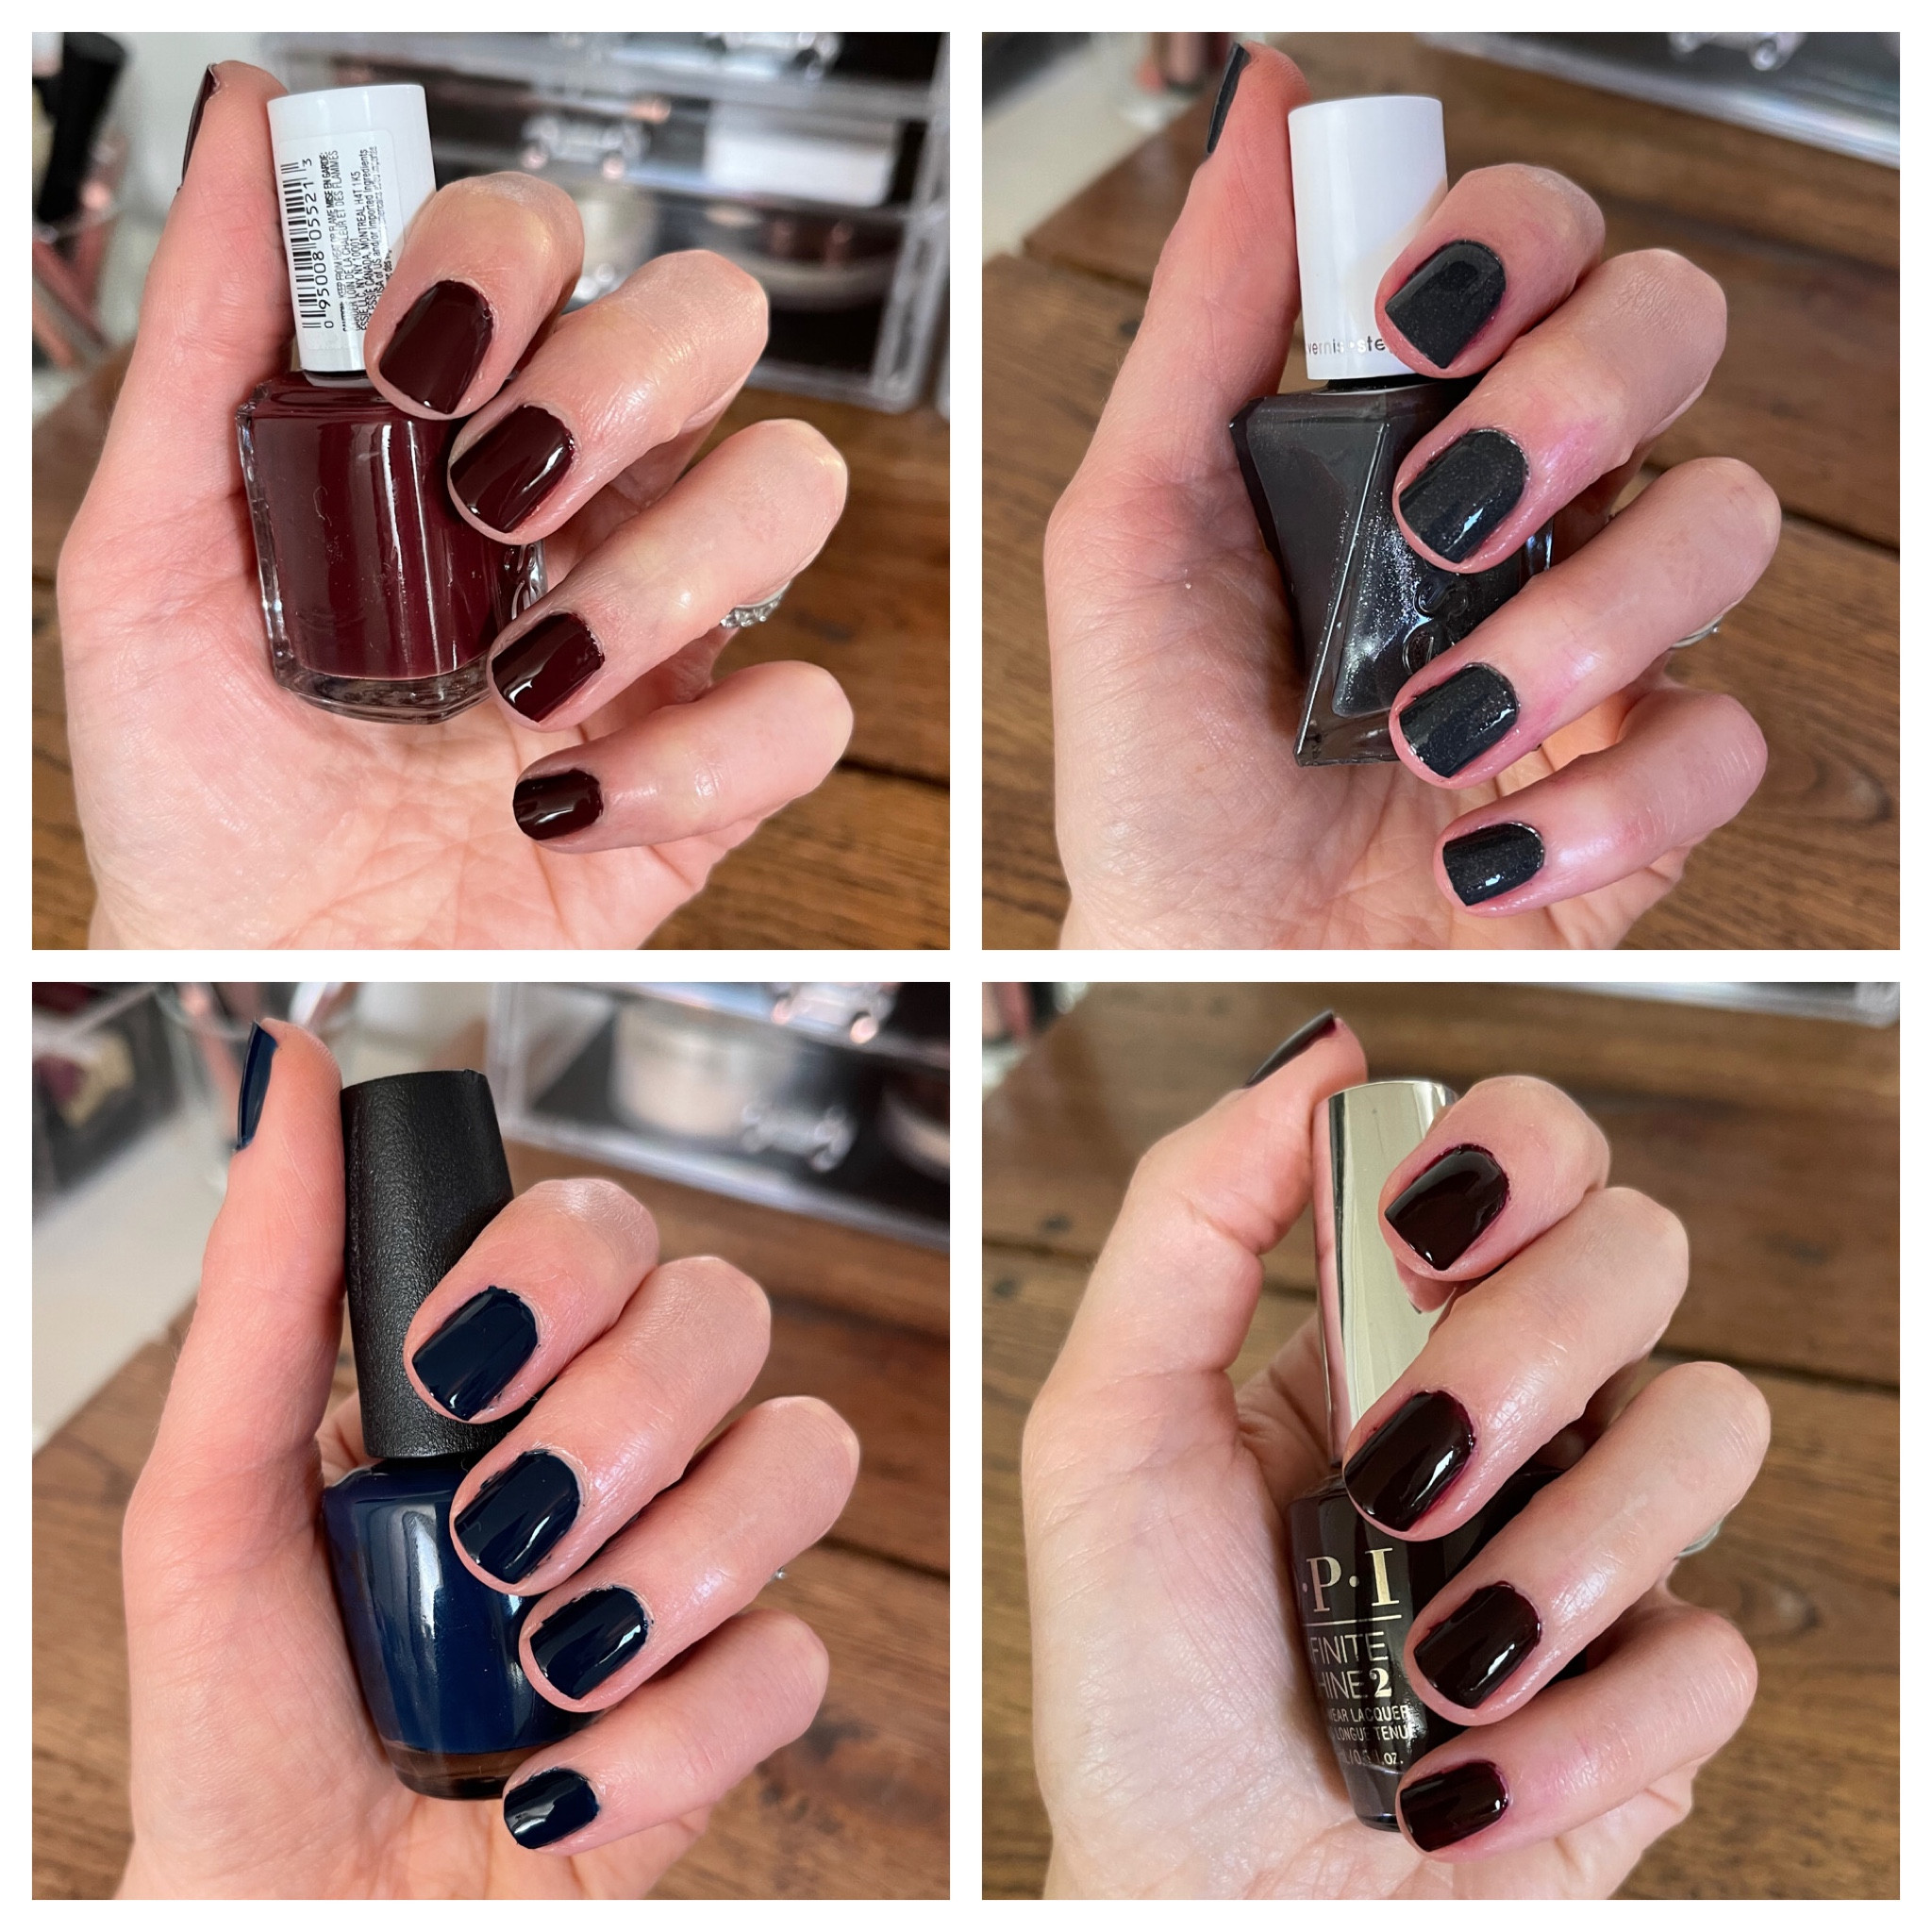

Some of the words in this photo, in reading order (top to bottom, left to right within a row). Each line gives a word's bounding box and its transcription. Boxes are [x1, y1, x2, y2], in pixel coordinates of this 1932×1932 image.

[302, 158, 311, 167] 3
[327, 150, 342, 189] FLAMMES
[357, 147, 375, 192] Ingredients
[322, 178, 331, 189] EN
[350, 170, 361, 186] 1K5
[333, 191, 344, 207] DES
[352, 189, 364, 205] H4T
[302, 181, 322, 241] 05521
[335, 208, 345, 219] ET
[362, 193, 378, 230] Imported
[355, 206, 370, 249] MONTREAL
[337, 220, 351, 255] CHALEUR
[368, 230, 381, 257] and/or
[349, 237, 361, 260] 10001
[342, 257, 352, 268] LA
[352, 262, 363, 275] NY
[371, 258, 382, 269] US
[311, 250, 331, 309] 95008
[343, 268, 354, 279] DE
[373, 270, 383, 279] of
[345, 280, 357, 299] LOIN
[324, 320, 333, 328] 0
[1369, 1667, 1392, 1698] 2
